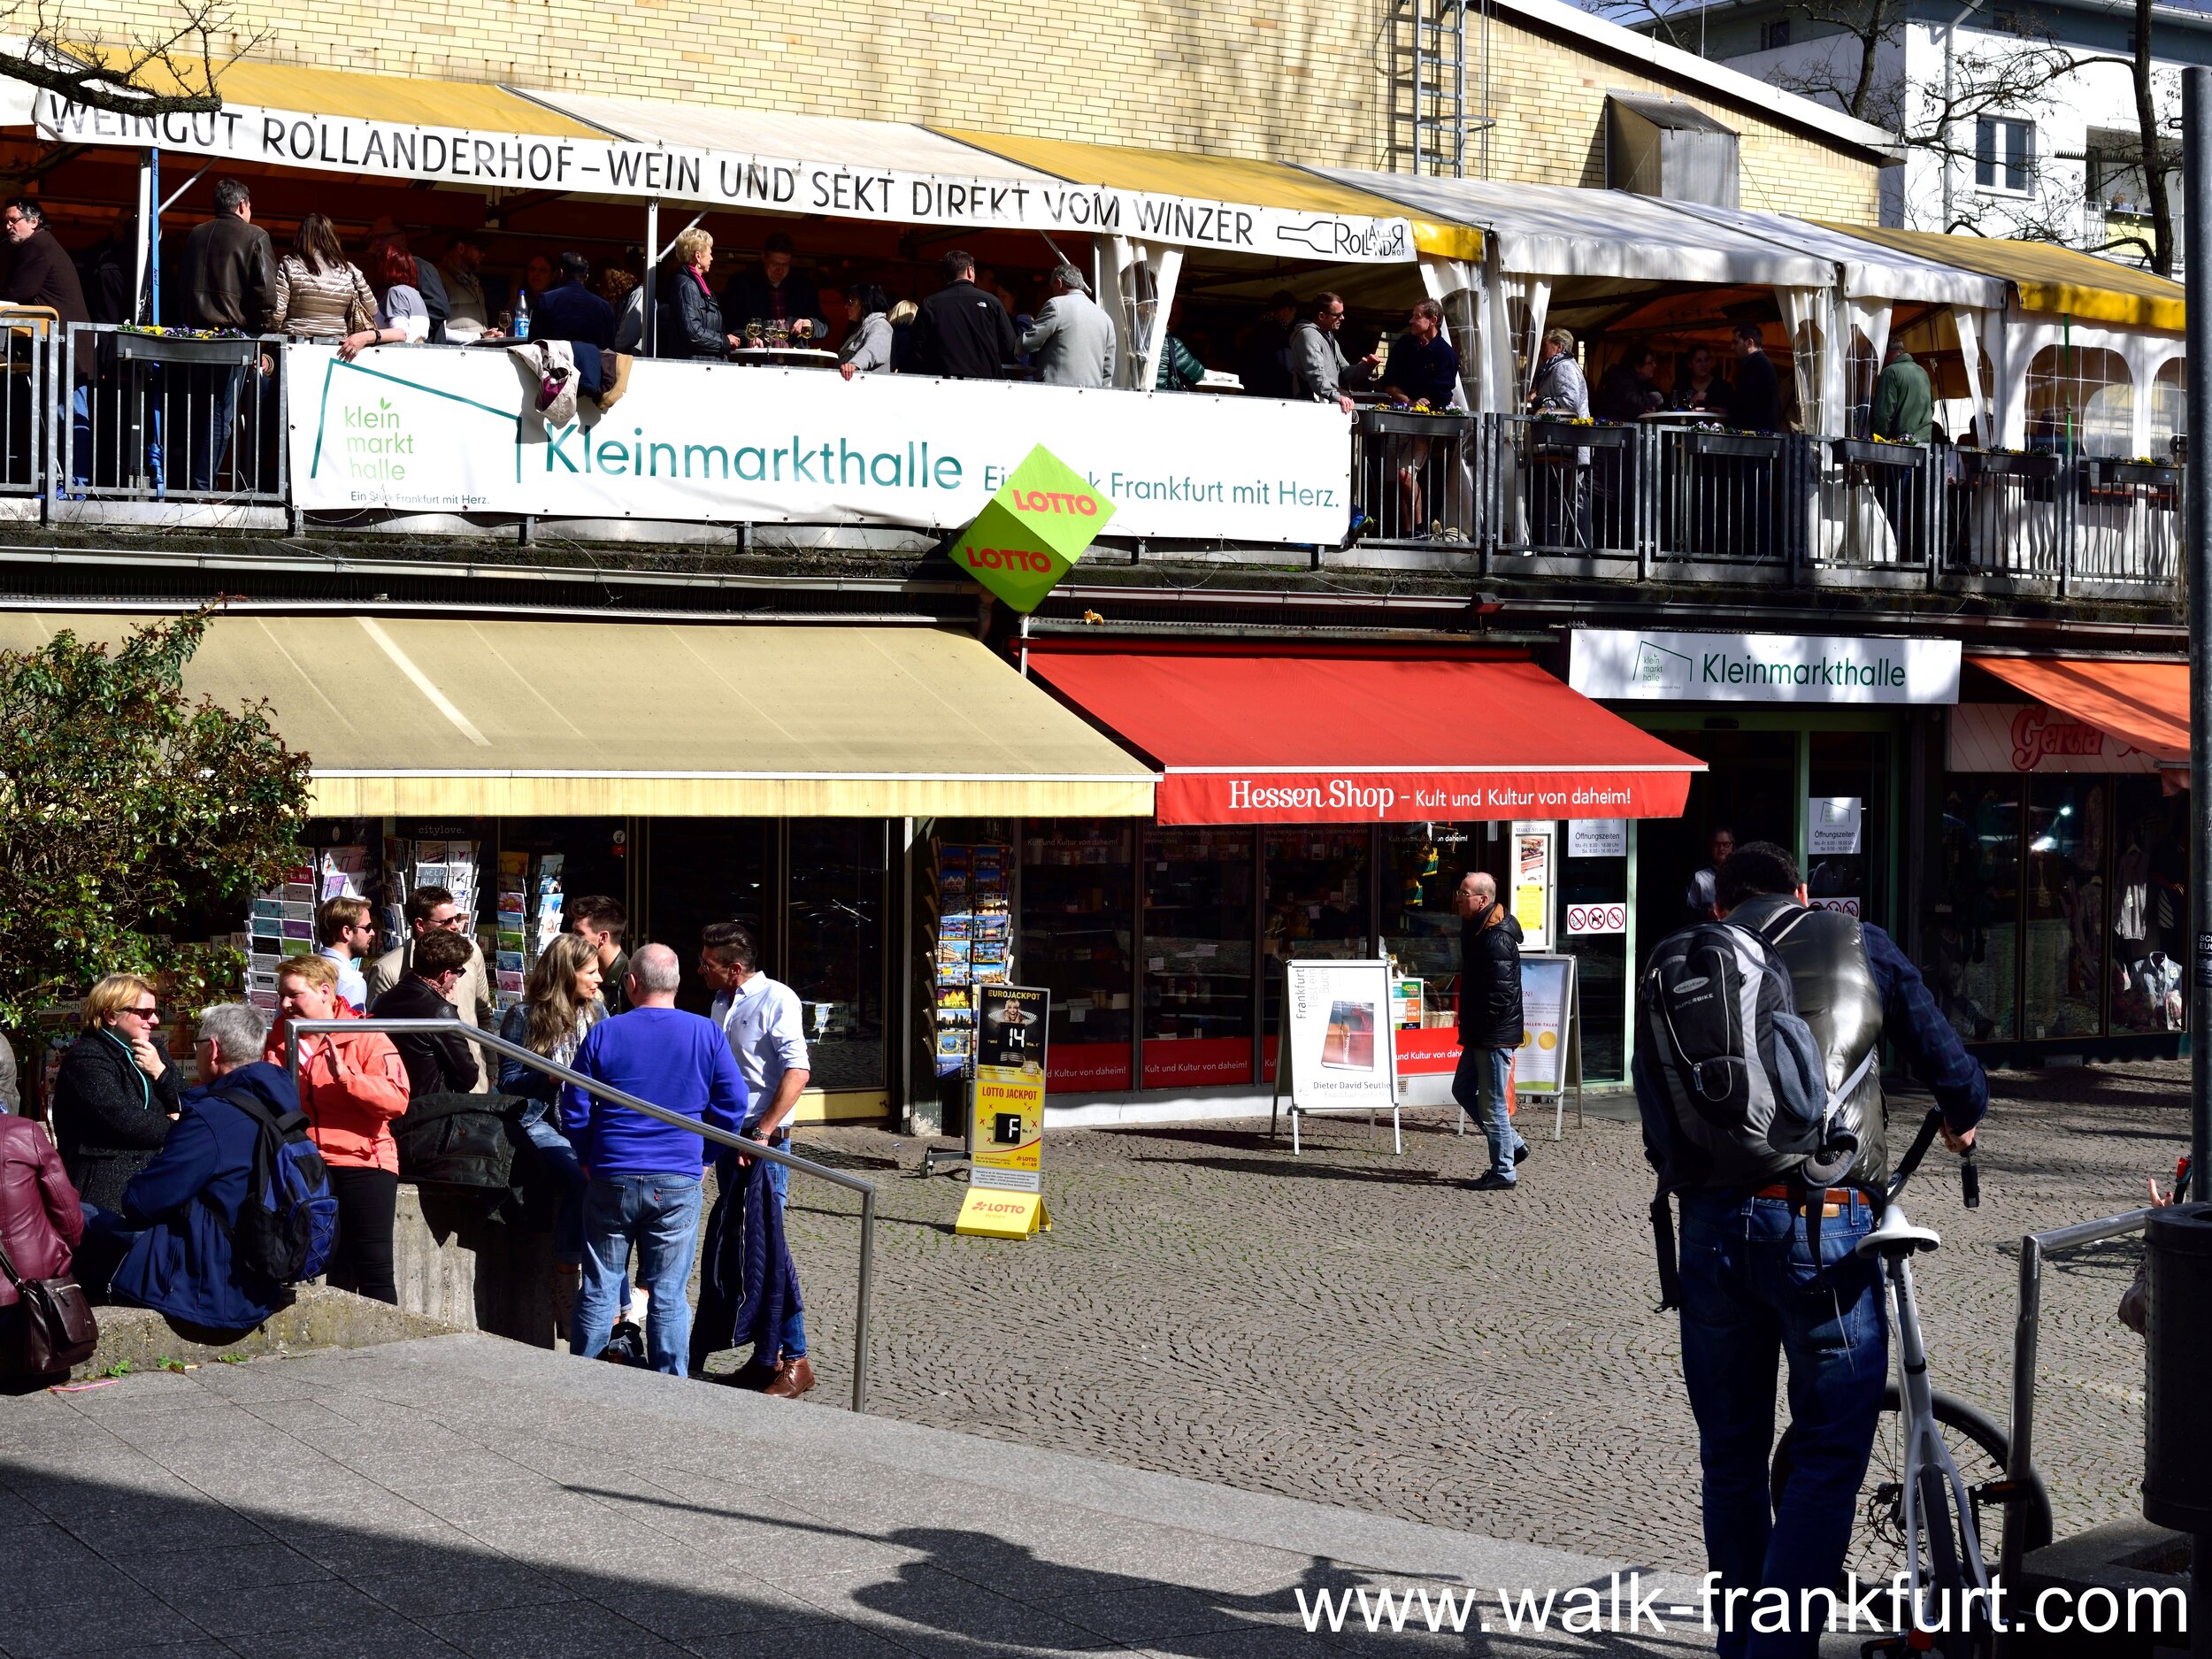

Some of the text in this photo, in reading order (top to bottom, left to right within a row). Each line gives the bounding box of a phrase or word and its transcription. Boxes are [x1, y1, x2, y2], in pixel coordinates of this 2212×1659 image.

[50, 94, 242, 150] WEINGUT
[720, 160, 795, 204] UND
[812, 171, 893, 213] SEKT
[913, 181, 1029, 224] DIREKT
[1044, 188, 1119, 229] VOM
[1135, 199, 1253, 245] WINZER
[344, 403, 400, 428] klein
[346, 432, 413, 454] markt
[349, 457, 405, 480] halle
[545, 422, 964, 490] Kleinmarkthalle
[1110, 472, 1224, 503] Frankfurt
[1233, 481, 1270, 505] mit
[1279, 480, 1340, 508] Herz.
[350, 490, 489, 504] Ein Stück Frankfurt mit Herz.
[1011, 488, 1098, 517] LOTTO
[966, 546, 1052, 573] LOTTO
[1643, 655, 1660, 664] klein
[1702, 652, 1906, 687] Kleinmarkthalle
[2010, 707, 2104, 772] Gerda
[1228, 780, 1327, 810] Hessen
[1328, 779, 1394, 818] Shop
[1416, 788, 1447, 807] Kult
[1452, 787, 1481, 807] und
[1488, 787, 1535, 806] Kultur
[1539, 791, 1566, 806] von
[1571, 787, 1632, 805] daheim!
[419, 824, 465, 836] citylove.
[1575, 832, 1620, 841] Öffnungszeiten
[1814, 830, 1855, 840] Öffnungszeiten
[425, 868, 444, 877] NEED
[987, 989, 1041, 1001] EUROJACKPOT
[1294, 968, 1307, 1019] Frankfurt
[1674, 992, 1714, 1011] SUPERBIKE
[1009, 1027, 1025, 1048] 14
[1410, 1051, 1431, 1060] Kultur
[1054, 1067, 1078, 1078] Kultur
[1095, 1065, 1126, 1075] daheim!
[1144, 1064, 1160, 1073] Kult
[1162, 1063, 1177, 1072] und
[1178, 1062, 1201, 1071] Kultur
[1217, 1060, 1248, 1071] daheim!
[982, 1087, 1037, 1100] LOTTO JACKPOT
[987, 1202, 1025, 1214] LOTTO
